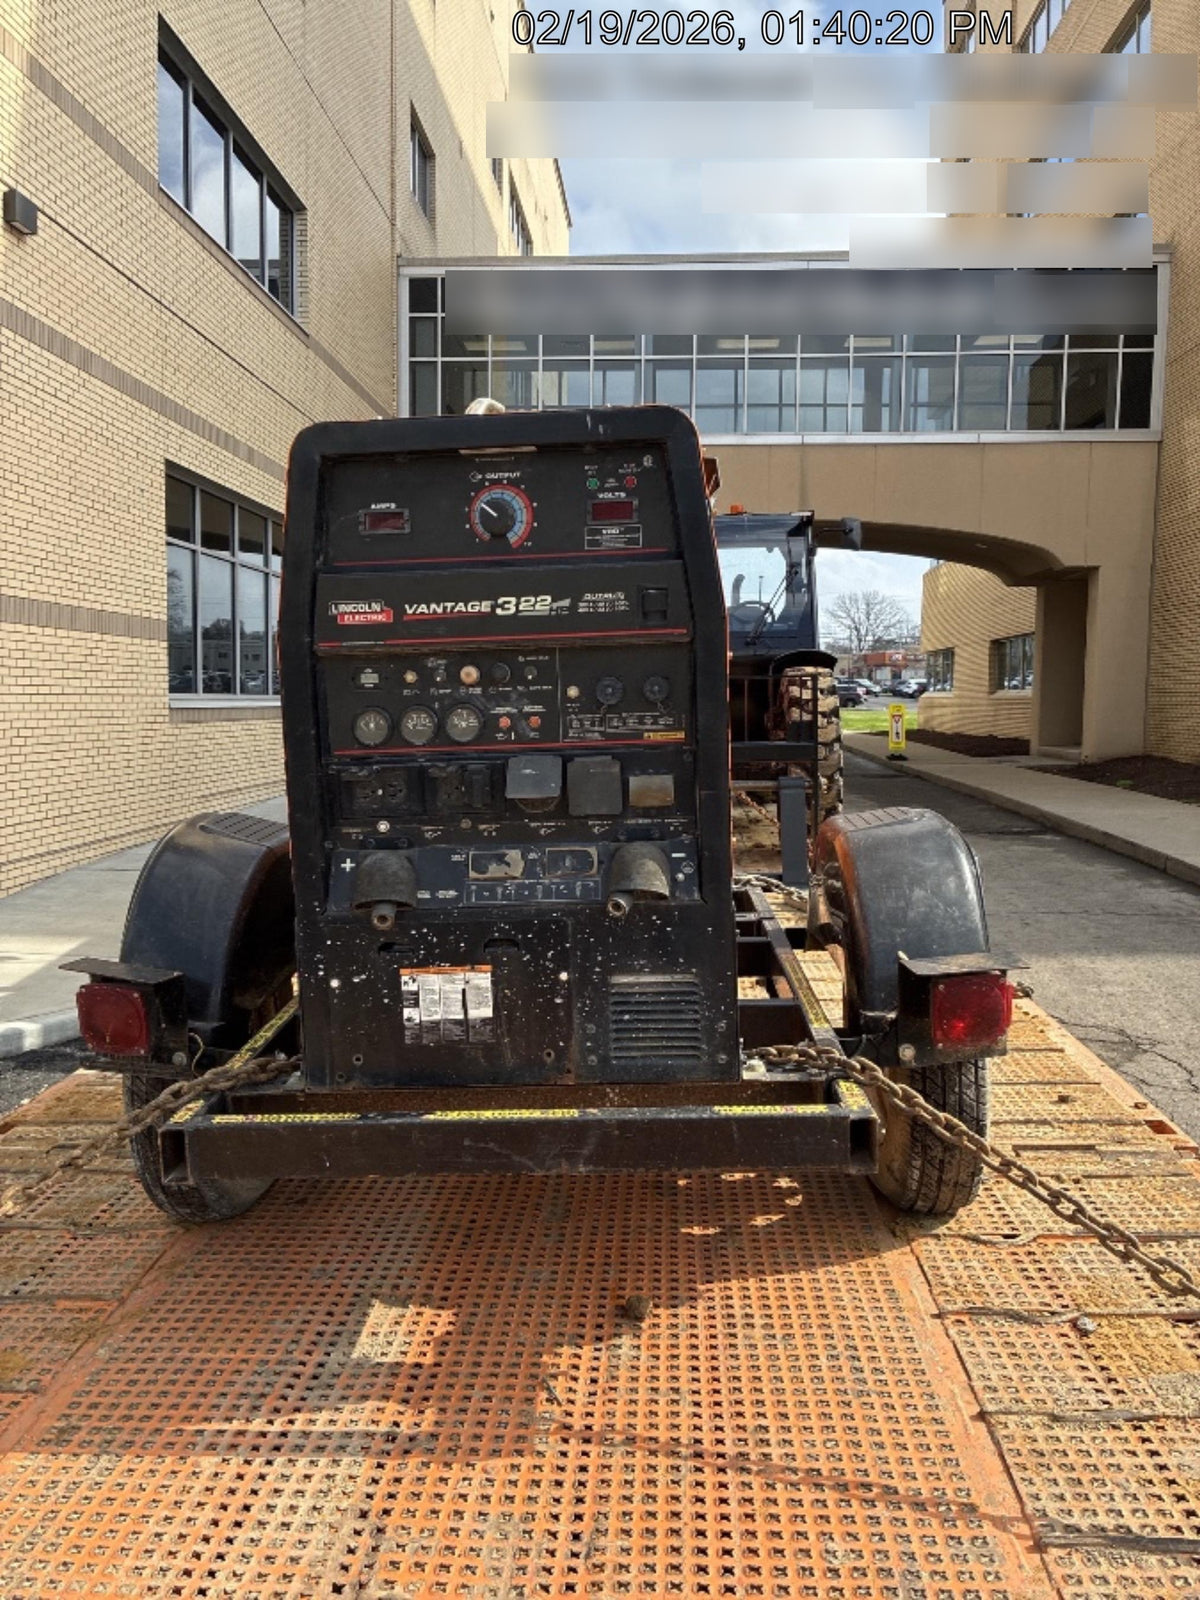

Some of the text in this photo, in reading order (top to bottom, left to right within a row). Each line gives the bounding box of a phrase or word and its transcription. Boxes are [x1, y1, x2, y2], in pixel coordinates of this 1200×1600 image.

[331, 602, 382, 615] LINCOLN
[404, 600, 492, 615] VANTAGE
[496, 594, 552, 616] 322
[344, 613, 387, 622] ELECTRIC
